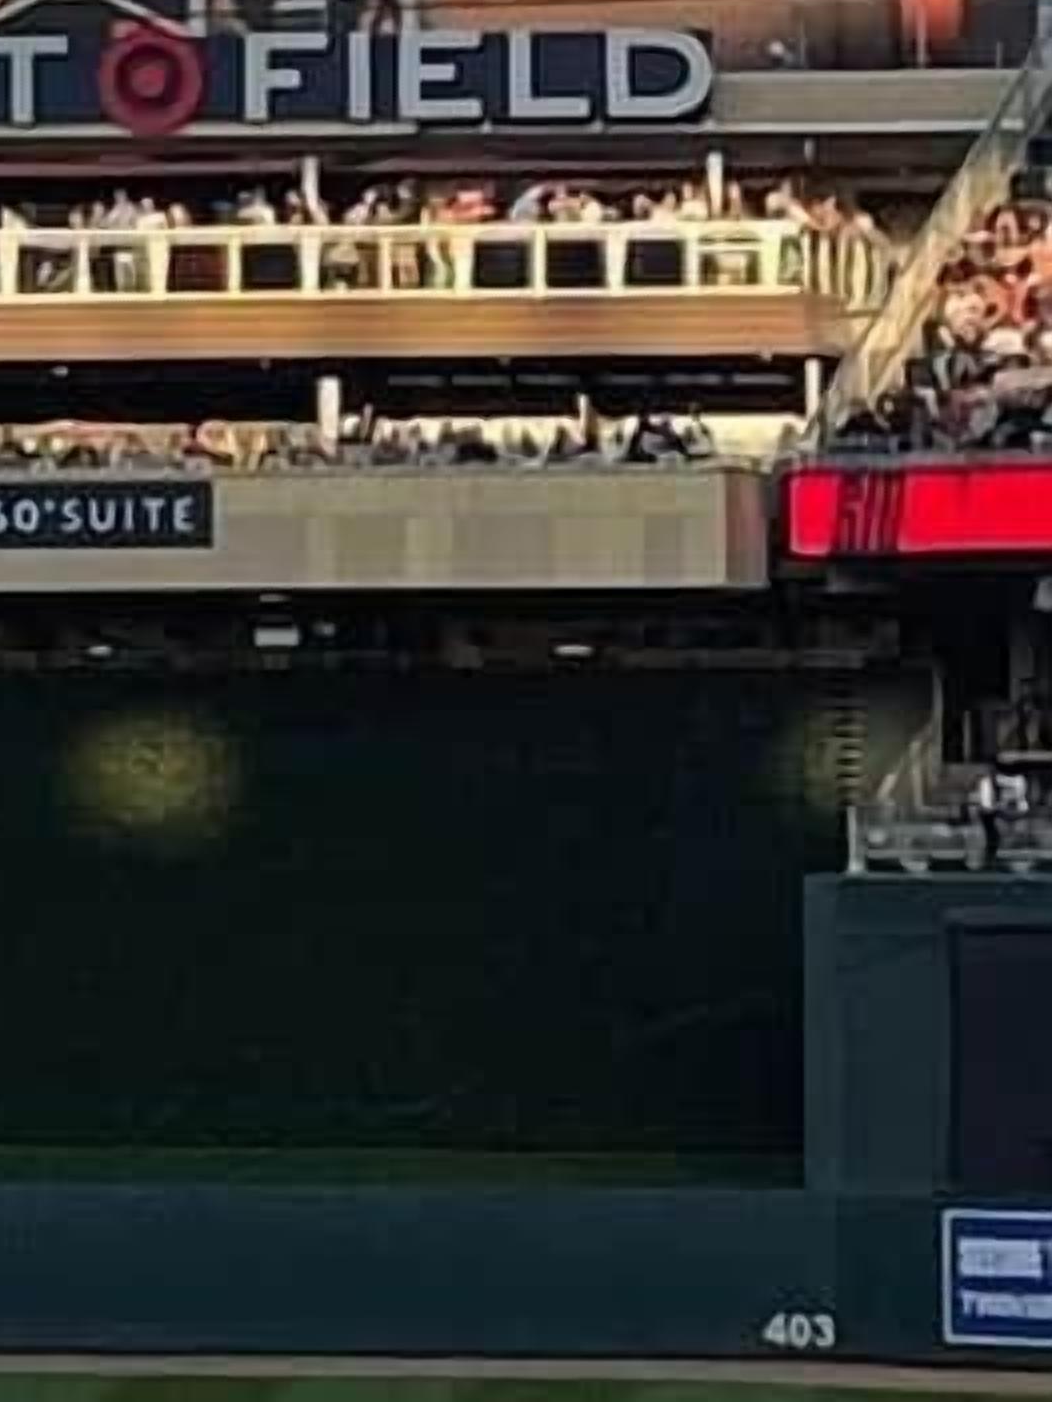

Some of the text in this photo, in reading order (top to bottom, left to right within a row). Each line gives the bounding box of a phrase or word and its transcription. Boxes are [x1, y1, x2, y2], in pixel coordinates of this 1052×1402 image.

[244, 30, 713, 121] FIELD
[60, 495, 196, 533] SUITE
[762, 1311, 836, 1348] 403
